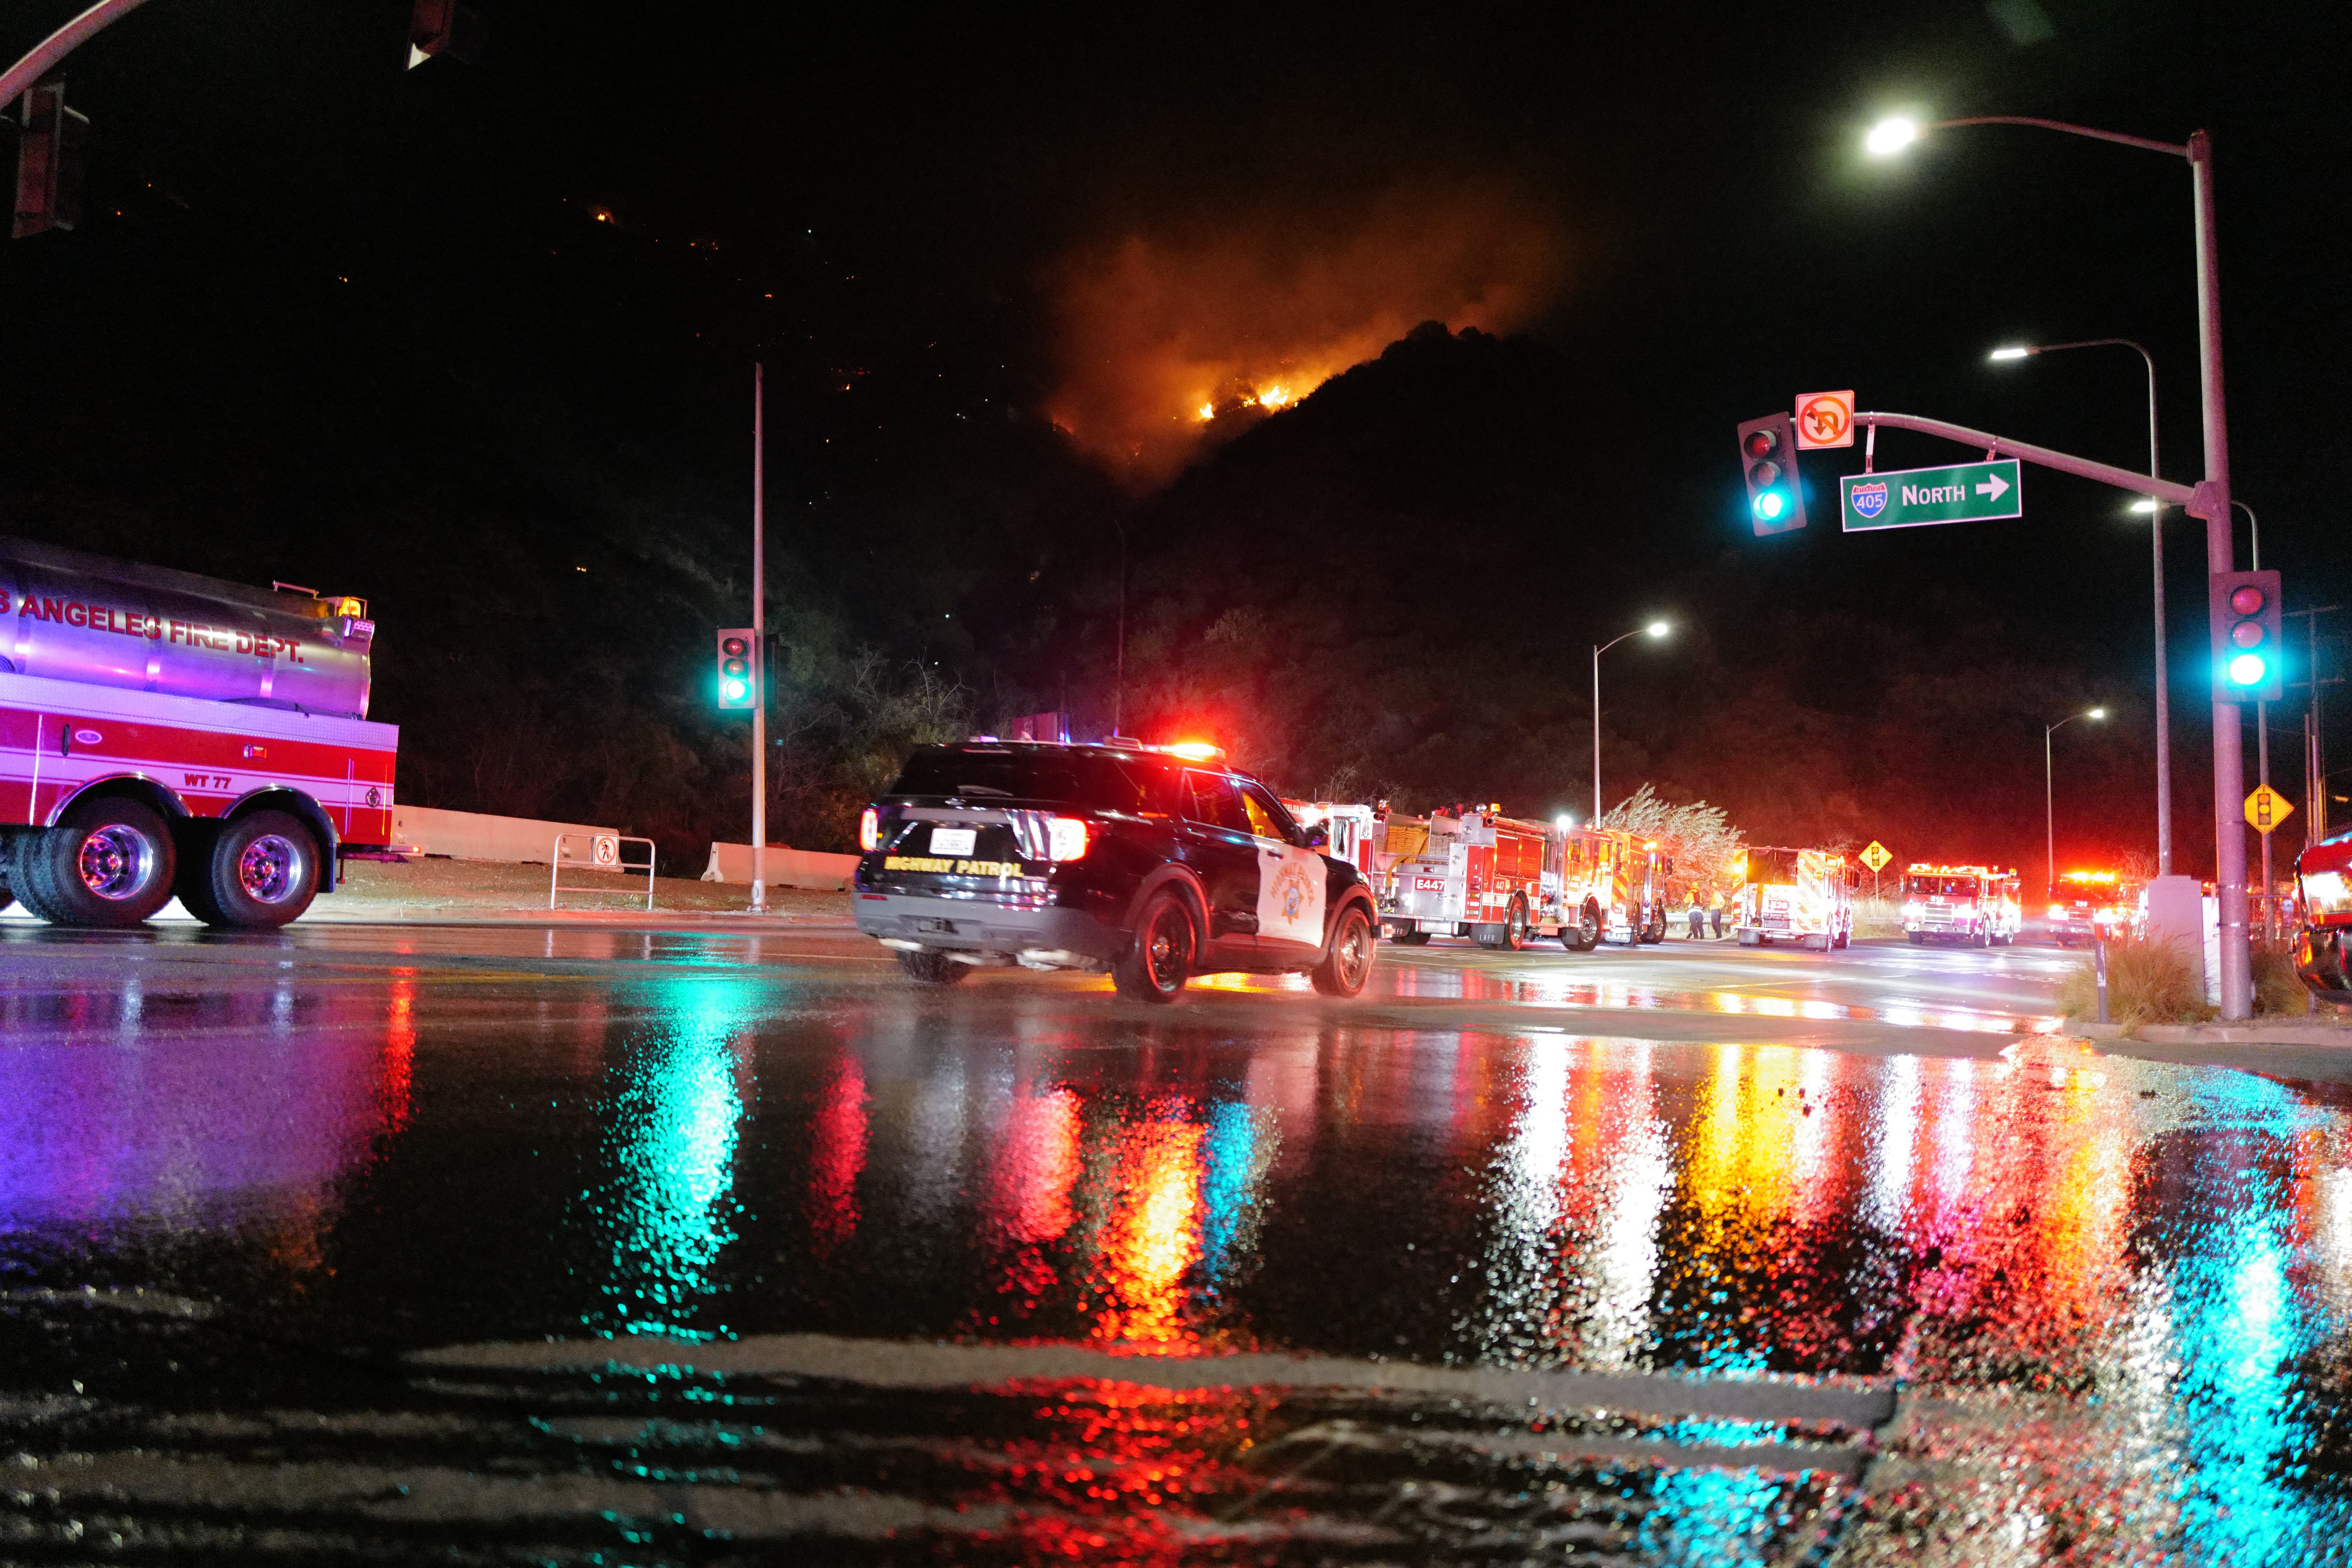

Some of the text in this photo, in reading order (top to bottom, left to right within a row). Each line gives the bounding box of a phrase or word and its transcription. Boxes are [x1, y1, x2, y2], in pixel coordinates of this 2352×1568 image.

[1856, 484, 1965, 508] 405 NORTH
[18, 594, 162, 640] ANGELES
[170, 620, 229, 651] FIRE
[236, 631, 304, 663] DEPT.
[184, 773, 232, 789] WT 77
[955, 859, 1025, 877] PATROL
[1417, 879, 1445, 891] E447
[1495, 880, 1504, 891] 447
